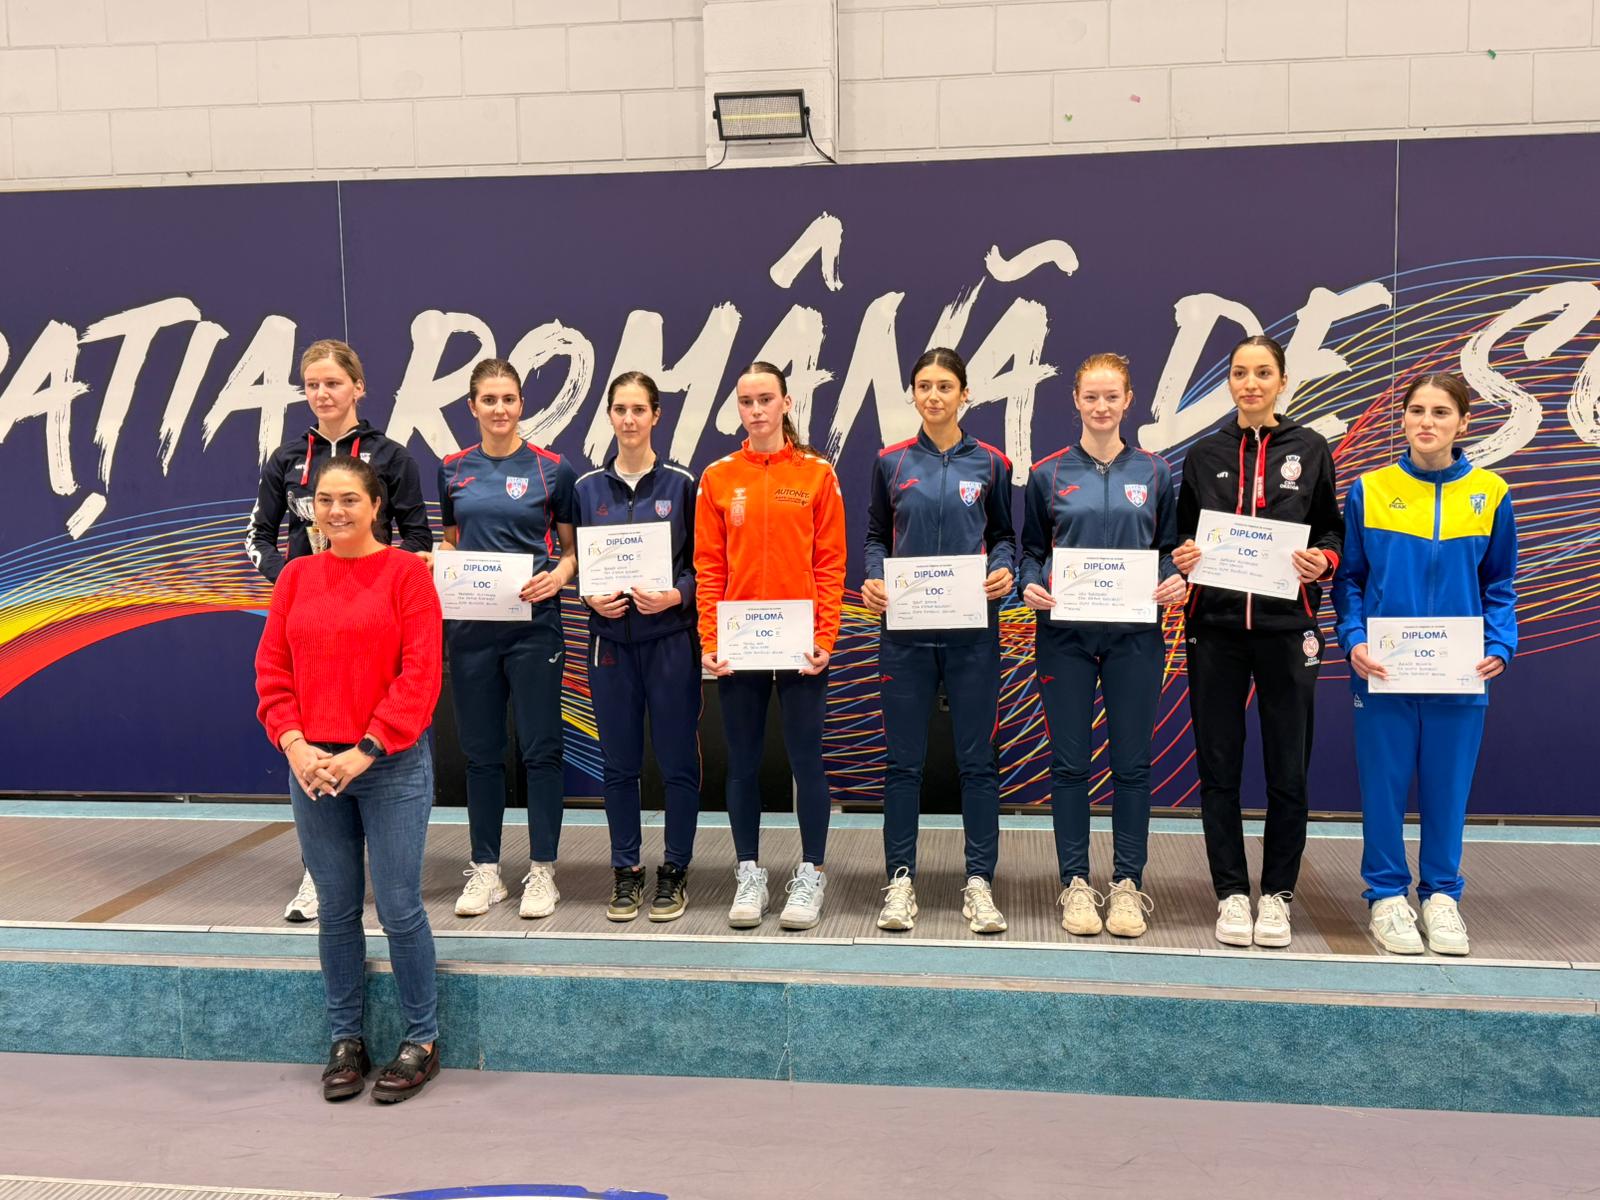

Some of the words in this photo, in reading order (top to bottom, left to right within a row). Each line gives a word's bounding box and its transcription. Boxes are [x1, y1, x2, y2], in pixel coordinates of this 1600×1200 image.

[0, 297, 306, 540] AȚIA
[1138, 282, 1392, 452] DE
[1238, 547, 1258, 557] LOC
[617, 554, 634, 562] LOC
[473, 581, 491, 589] LOC
[1094, 580, 1113, 588] LOC
[925, 587, 944, 595] LOC
[755, 629, 774, 637] LOC
[1414, 649, 1435, 658] LOC
